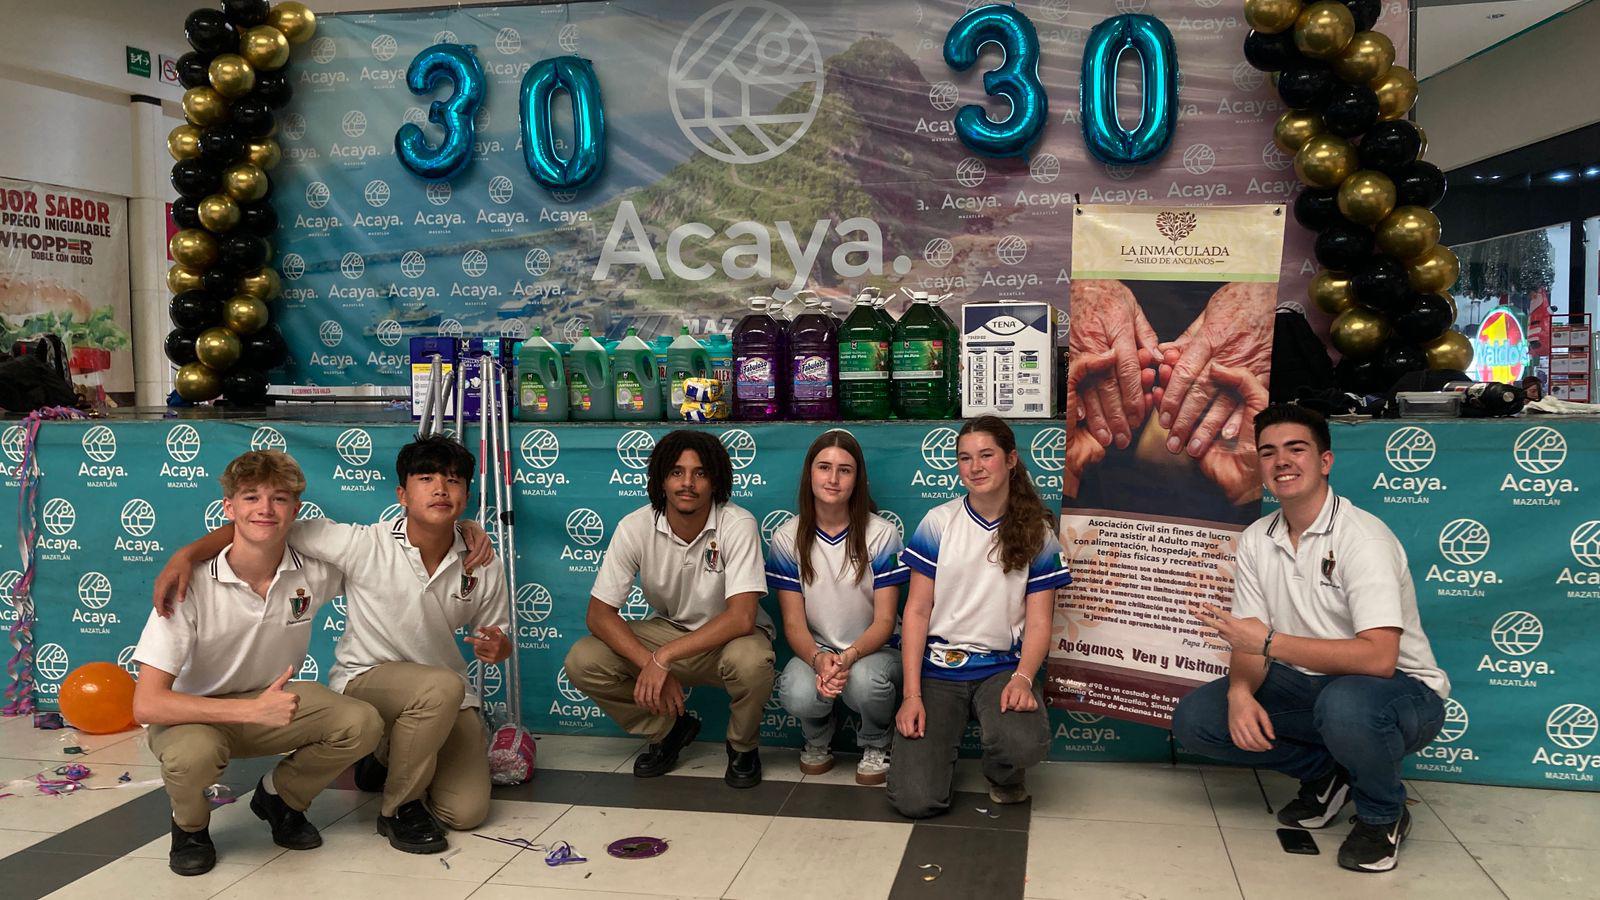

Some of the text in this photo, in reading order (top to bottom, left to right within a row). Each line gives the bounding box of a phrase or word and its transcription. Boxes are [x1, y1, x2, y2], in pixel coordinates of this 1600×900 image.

[1180, 15, 1241, 32] Acaya.
[299, 70, 350, 87] Acaya.
[360, 67, 406, 84] Acaya
[329, 144, 381, 160] Acaya.
[1014, 190, 1076, 208] Acaya.
[1090, 187, 1153, 205] Acaya.
[1167, 181, 1232, 200] Acaya.
[0, 188, 110, 225] JOR SABOR
[941, 193, 1002, 212] Acaya.
[2, 212, 111, 238] PRECIO INIGUALABLE
[294, 214, 342, 231] Acaya.
[352, 212, 403, 230] Acaya.
[414, 211, 466, 229] Acaya.
[476, 209, 529, 227] Acaya.
[539, 207, 592, 226] Acaya.
[31, 250, 93, 265] DOBLE CON QUESO
[591, 200, 912, 300] Acaya.
[1121, 245, 1230, 257] LA INMACULADA
[1134, 257, 1157, 265] ASILO
[1174, 257, 1215, 265] ANCIANOS
[512, 280, 566, 298] Acaya.
[981, 271, 1043, 289] Acaya.
[328, 284, 379, 302] Acaya.
[389, 283, 440, 300] Acaya.
[450, 282, 502, 299] Acaya.
[309, 351, 357, 367] Acaya.
[743, 361, 768, 374] Fabuloso
[801, 360, 826, 373] Fabuloso
[78, 462, 128, 481] Acaya.
[160, 462, 209, 481] Acaya.
[332, 465, 386, 485] Acaya.
[513, 468, 570, 488] Acaya.
[87, 480, 117, 488] MAZATLÁN
[167, 481, 198, 489] MAZATLÁN
[340, 484, 375, 492] MAZATLÁN
[1372, 473, 1447, 495] Acaya.
[1500, 474, 1579, 496] Acaya.
[921, 491, 961, 499] MAZATLÁN
[1384, 496, 1429, 504] MAZATLÁN
[1512, 498, 1561, 506] MAZATLÁN
[1088, 519, 1231, 542] Asociación Civil sin fines de lucro
[1099, 529, 1219, 550] Para asistir al Adulto mayor
[36, 535, 81, 553] Acaya.
[114, 536, 164, 554] Acaya.
[1073, 537, 1237, 562] con alimentación, hospedaje, medicin
[41, 553, 70, 561] MAZATLÁN
[122, 554, 153, 562] MAZATLÁN
[1072, 558, 1097, 566] también
[1110, 563, 1138, 571] ancianos
[1097, 548, 1218, 570] terapias físicas y recreativas
[1140, 574, 1152, 582] Son
[1153, 577, 1197, 588] abandonados
[1425, 565, 1502, 587] Acaya.
[1114, 581, 1139, 590] aceptar
[1153, 586, 1193, 597] limitaciones
[1194, 591, 1206, 599] que
[1437, 588, 1485, 597] MAZATLÁN
[72, 608, 120, 626] Acaya.
[1098, 606, 1131, 616] referentes
[1161, 615, 1185, 624] modelo
[1178, 627, 1199, 636] puede
[1182, 638, 1201, 648] Papa
[1058, 638, 1231, 676] Apóyanos, Ven y Visitano
[1477, 654, 1555, 678] Acaya.
[1066, 679, 1087, 688] Mayo
[1121, 688, 1150, 699] costado
[1151, 692, 1161, 701] de
[1163, 694, 1170, 703] la
[1489, 679, 1537, 688] MAZATLÁN
[1059, 686, 1087, 697] Colonia
[1088, 690, 1112, 700] Centro
[549, 700, 605, 719] Acaya.
[1088, 699, 1107, 708] Asilo
[1108, 702, 1118, 710] de
[1119, 704, 1151, 716] Ancianos
[1153, 711, 1163, 719] La
[559, 720, 593, 728] MAZATLÁN
[1054, 723, 1120, 744] Acaya.
[1065, 744, 1106, 752] MAZATLÁN
[1416, 763, 1462, 773] MAZATLÁN
[1545, 772, 1593, 782] MAZATLÁN
